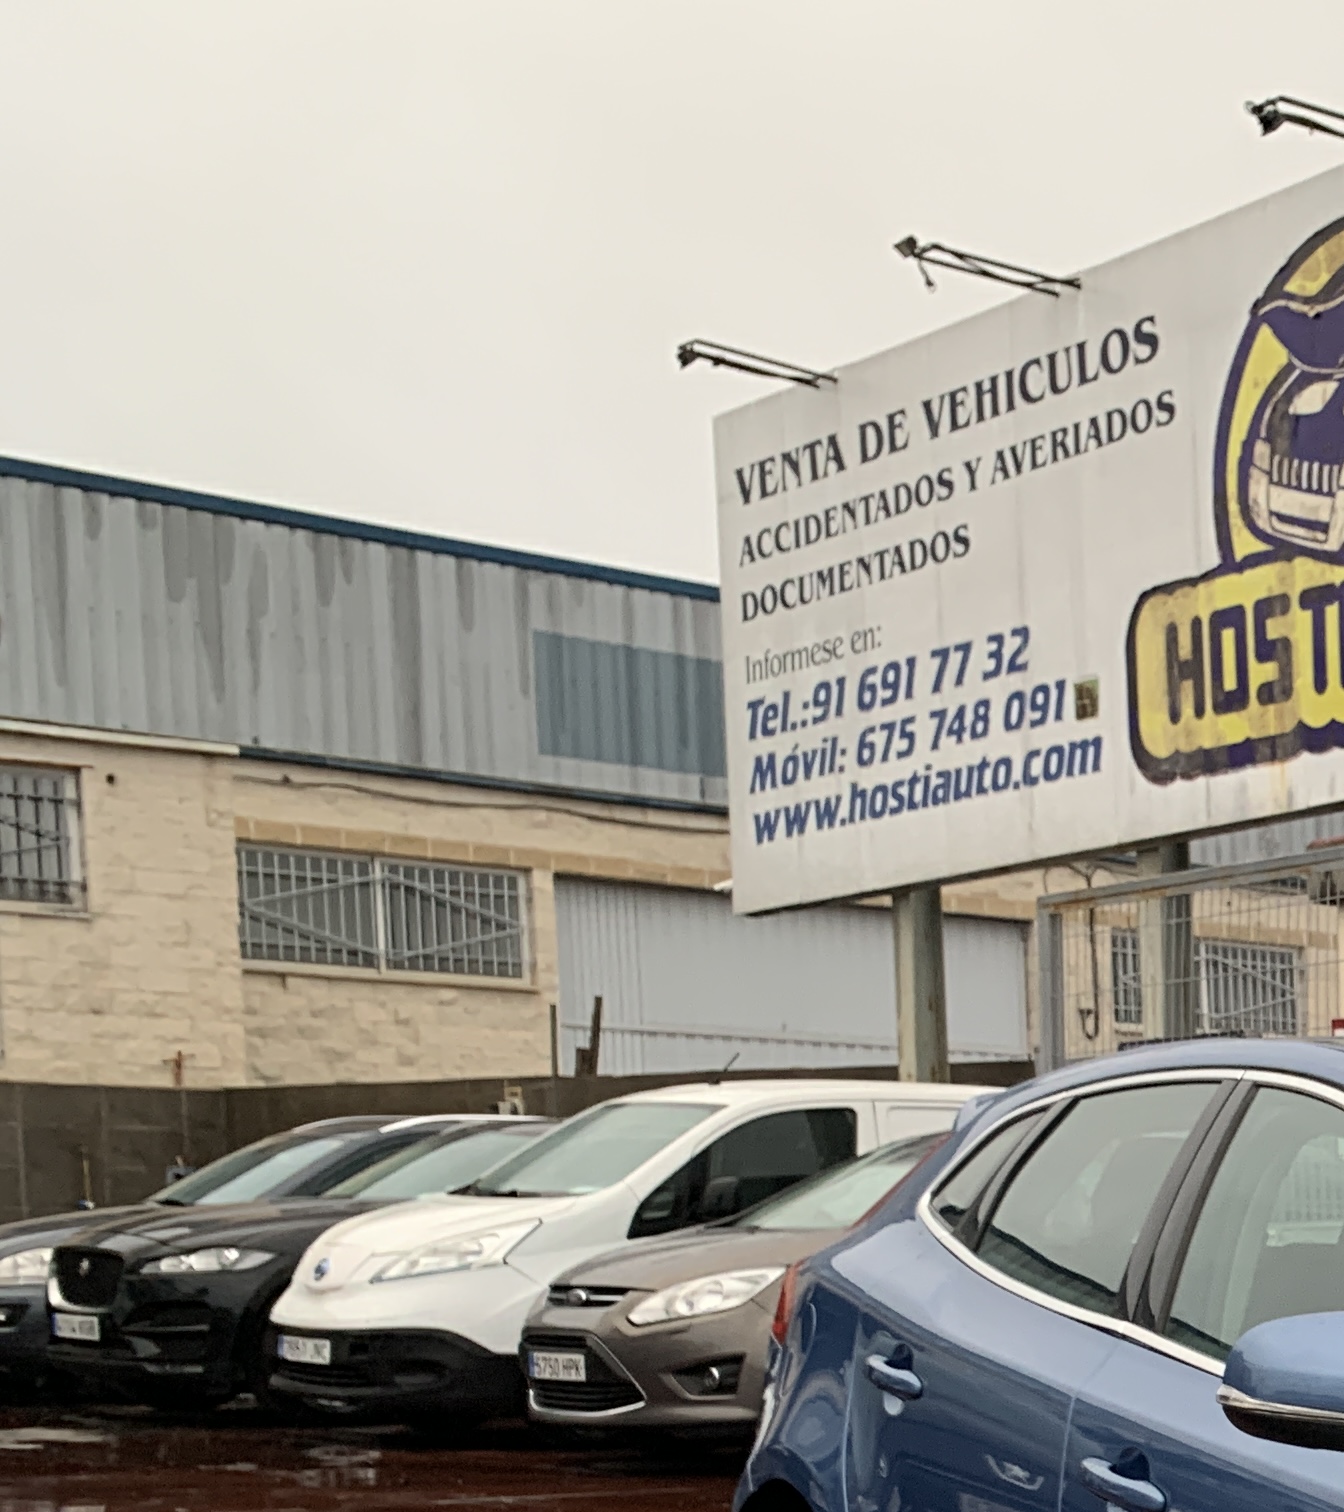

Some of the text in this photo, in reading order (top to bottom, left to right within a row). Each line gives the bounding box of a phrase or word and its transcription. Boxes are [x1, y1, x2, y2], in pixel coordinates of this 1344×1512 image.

[734, 314, 1161, 506] VENTA DE VEHICULOS
[739, 389, 1177, 568] ACCIDENTADOS Y AVERIADOS
[741, 523, 971, 623] DOCUMENTADOS
[745, 625, 882, 685] Informese en:
[747, 625, 1030, 741] Tel.:91 691 77 32
[749, 679, 1067, 795] Móvil: 675 748 091
[753, 735, 1103, 846] www.hostiauto.com
